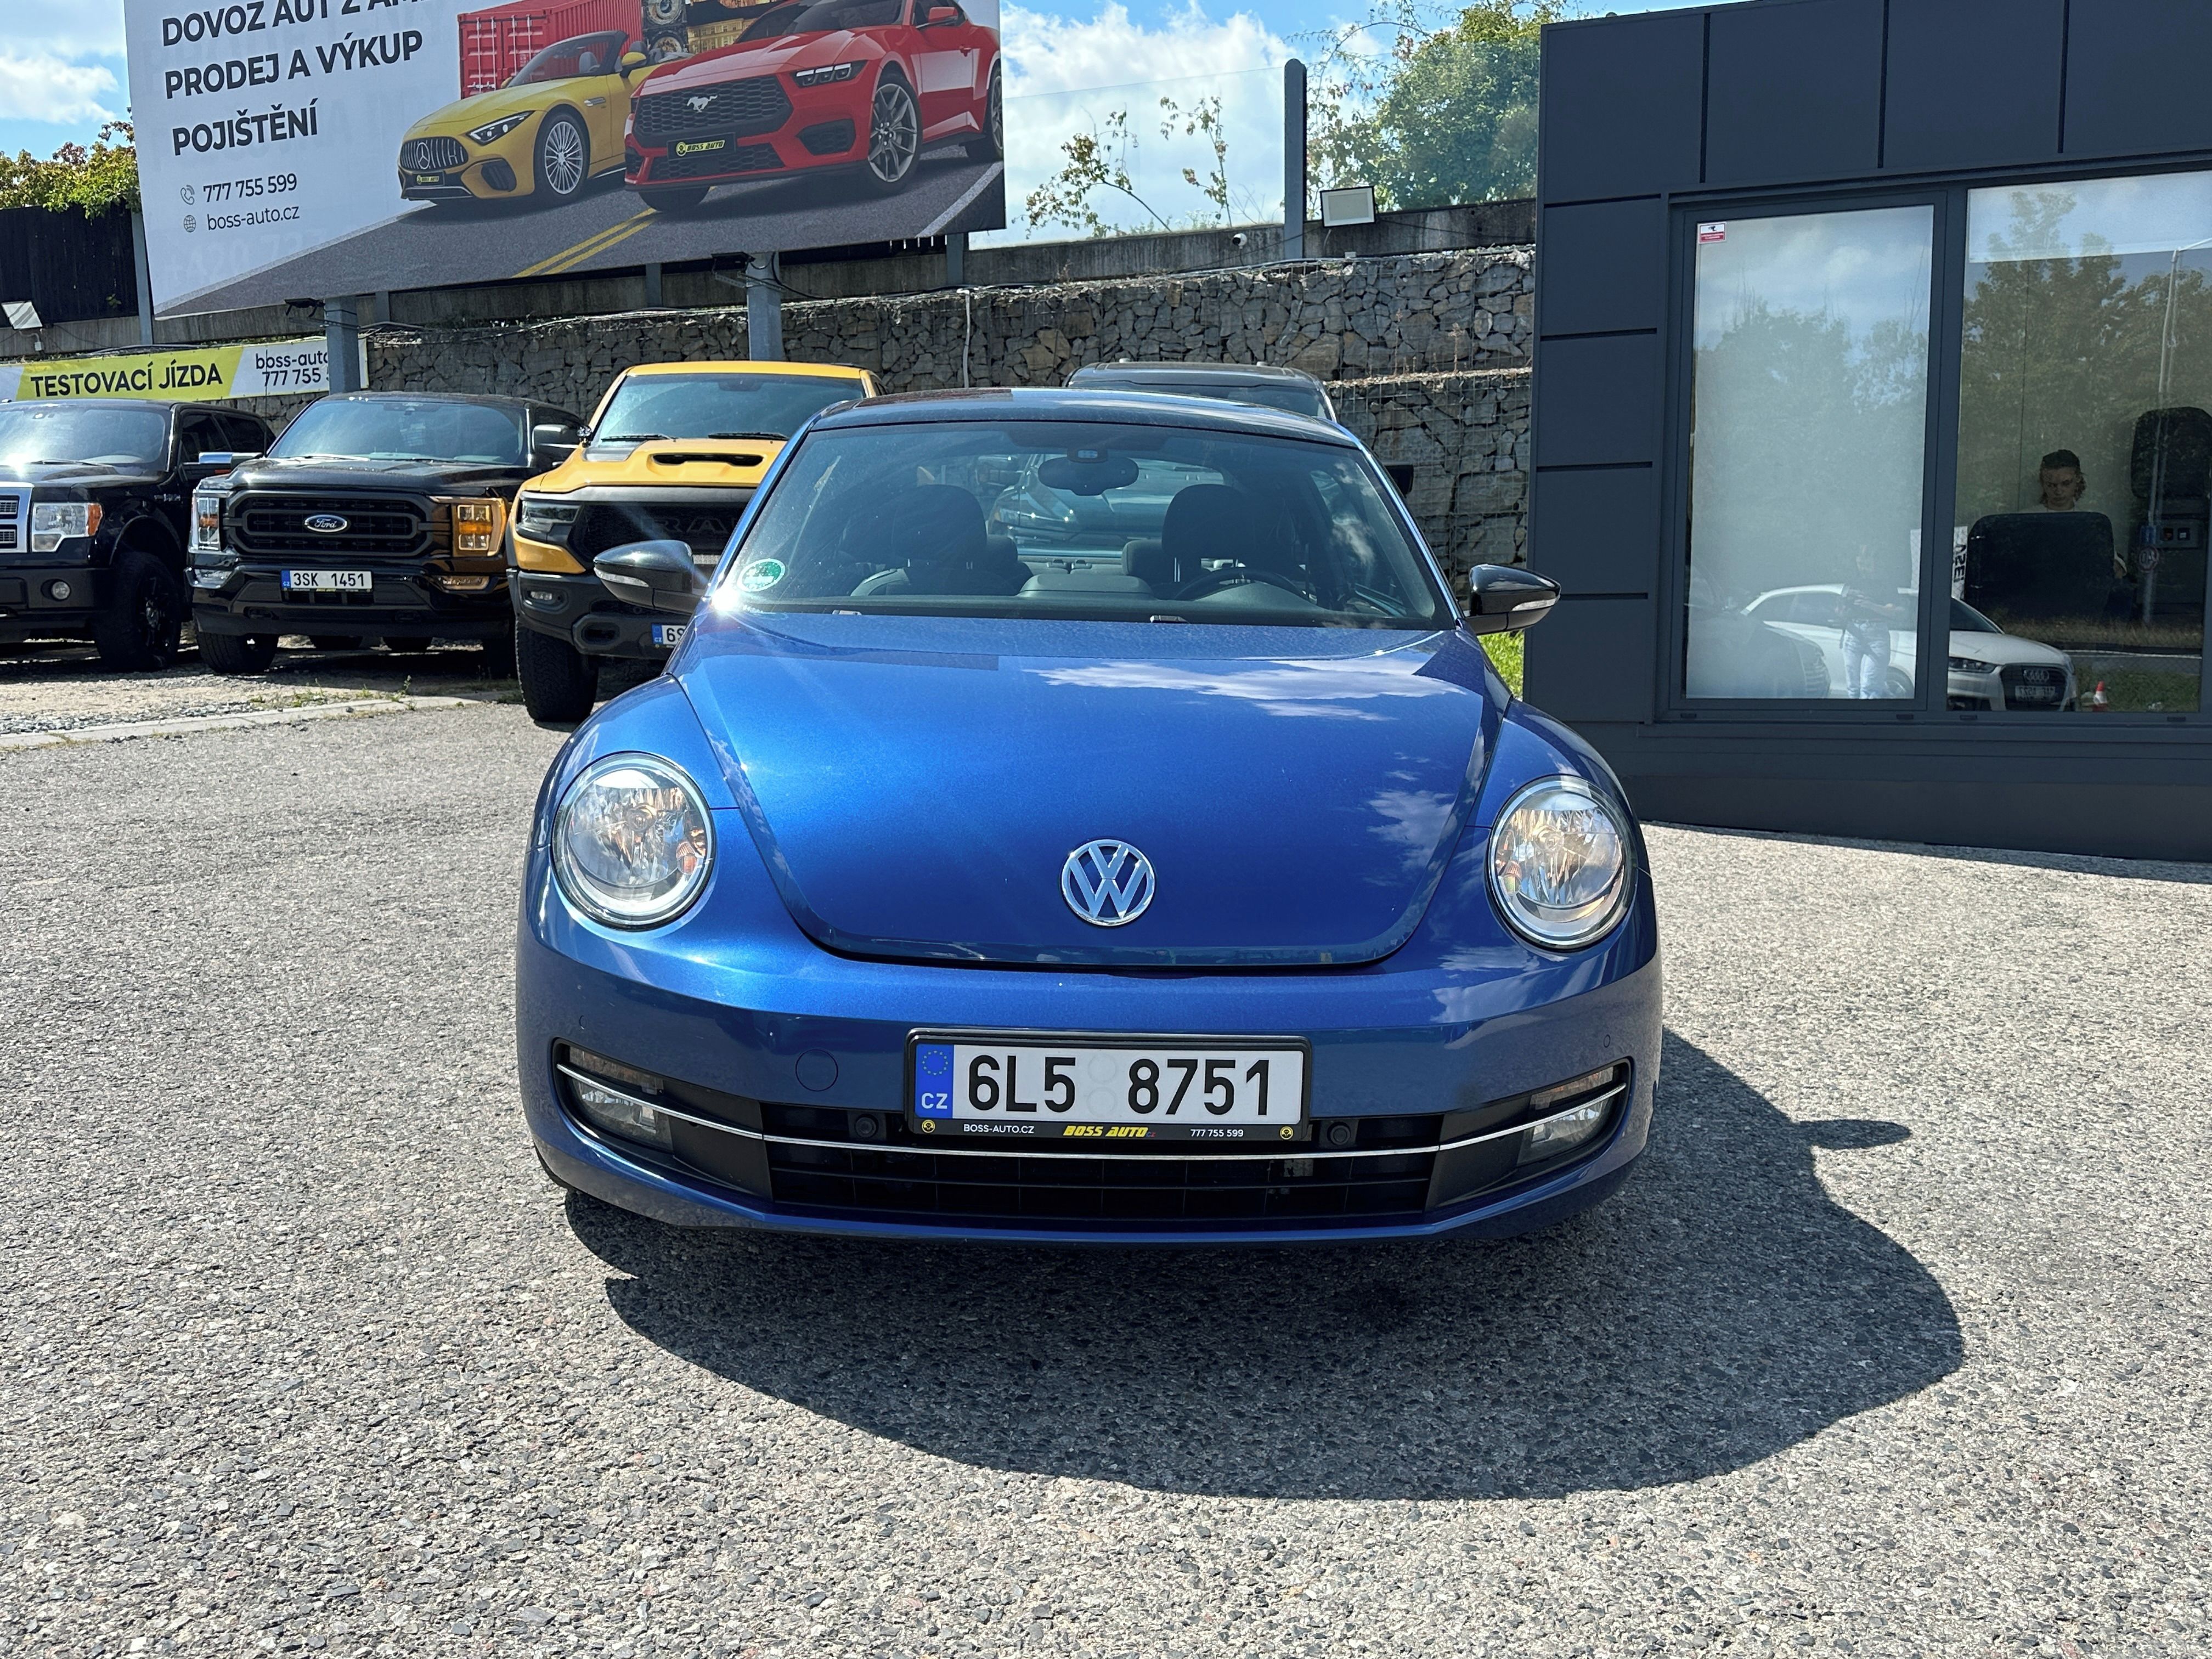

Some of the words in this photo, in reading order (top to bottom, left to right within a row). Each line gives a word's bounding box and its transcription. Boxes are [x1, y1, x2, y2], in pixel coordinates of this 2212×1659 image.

[163, 1, 266, 47] DOVOZ
[272, 0, 328, 27] AUT
[166, 53, 279, 99] PRODEJ
[288, 49, 311, 80] A
[316, 30, 422, 74] VÝKUP
[172, 98, 318, 156] POJIŠTĚNÍ
[203, 183, 232, 202] 777
[235, 178, 263, 198] 755
[268, 173, 297, 193] 599
[207, 206, 300, 230] boss-auto.cz
[30, 361, 154, 397] TESTOVACÍ
[159, 359, 223, 389] JÍZDA
[262, 370, 287, 387] 777
[292, 368, 321, 385] 755
[314, 518, 337, 528] Ford
[653, 517, 738, 534] RA
[294, 573, 318, 586] 3SK
[331, 573, 364, 587] 1451
[968, 1054, 1076, 1113] 6L5
[1128, 1058, 1269, 1116] 8751
[922, 1092, 947, 1109] CZ
[963, 1124, 1035, 1133] BOSS-AUTO.CZ
[1063, 1125, 1104, 1136] BOSS
[1190, 1128, 1206, 1137] 777
[1208, 1129, 1224, 1137] 755
[1226, 1129, 1244, 1137] 599
